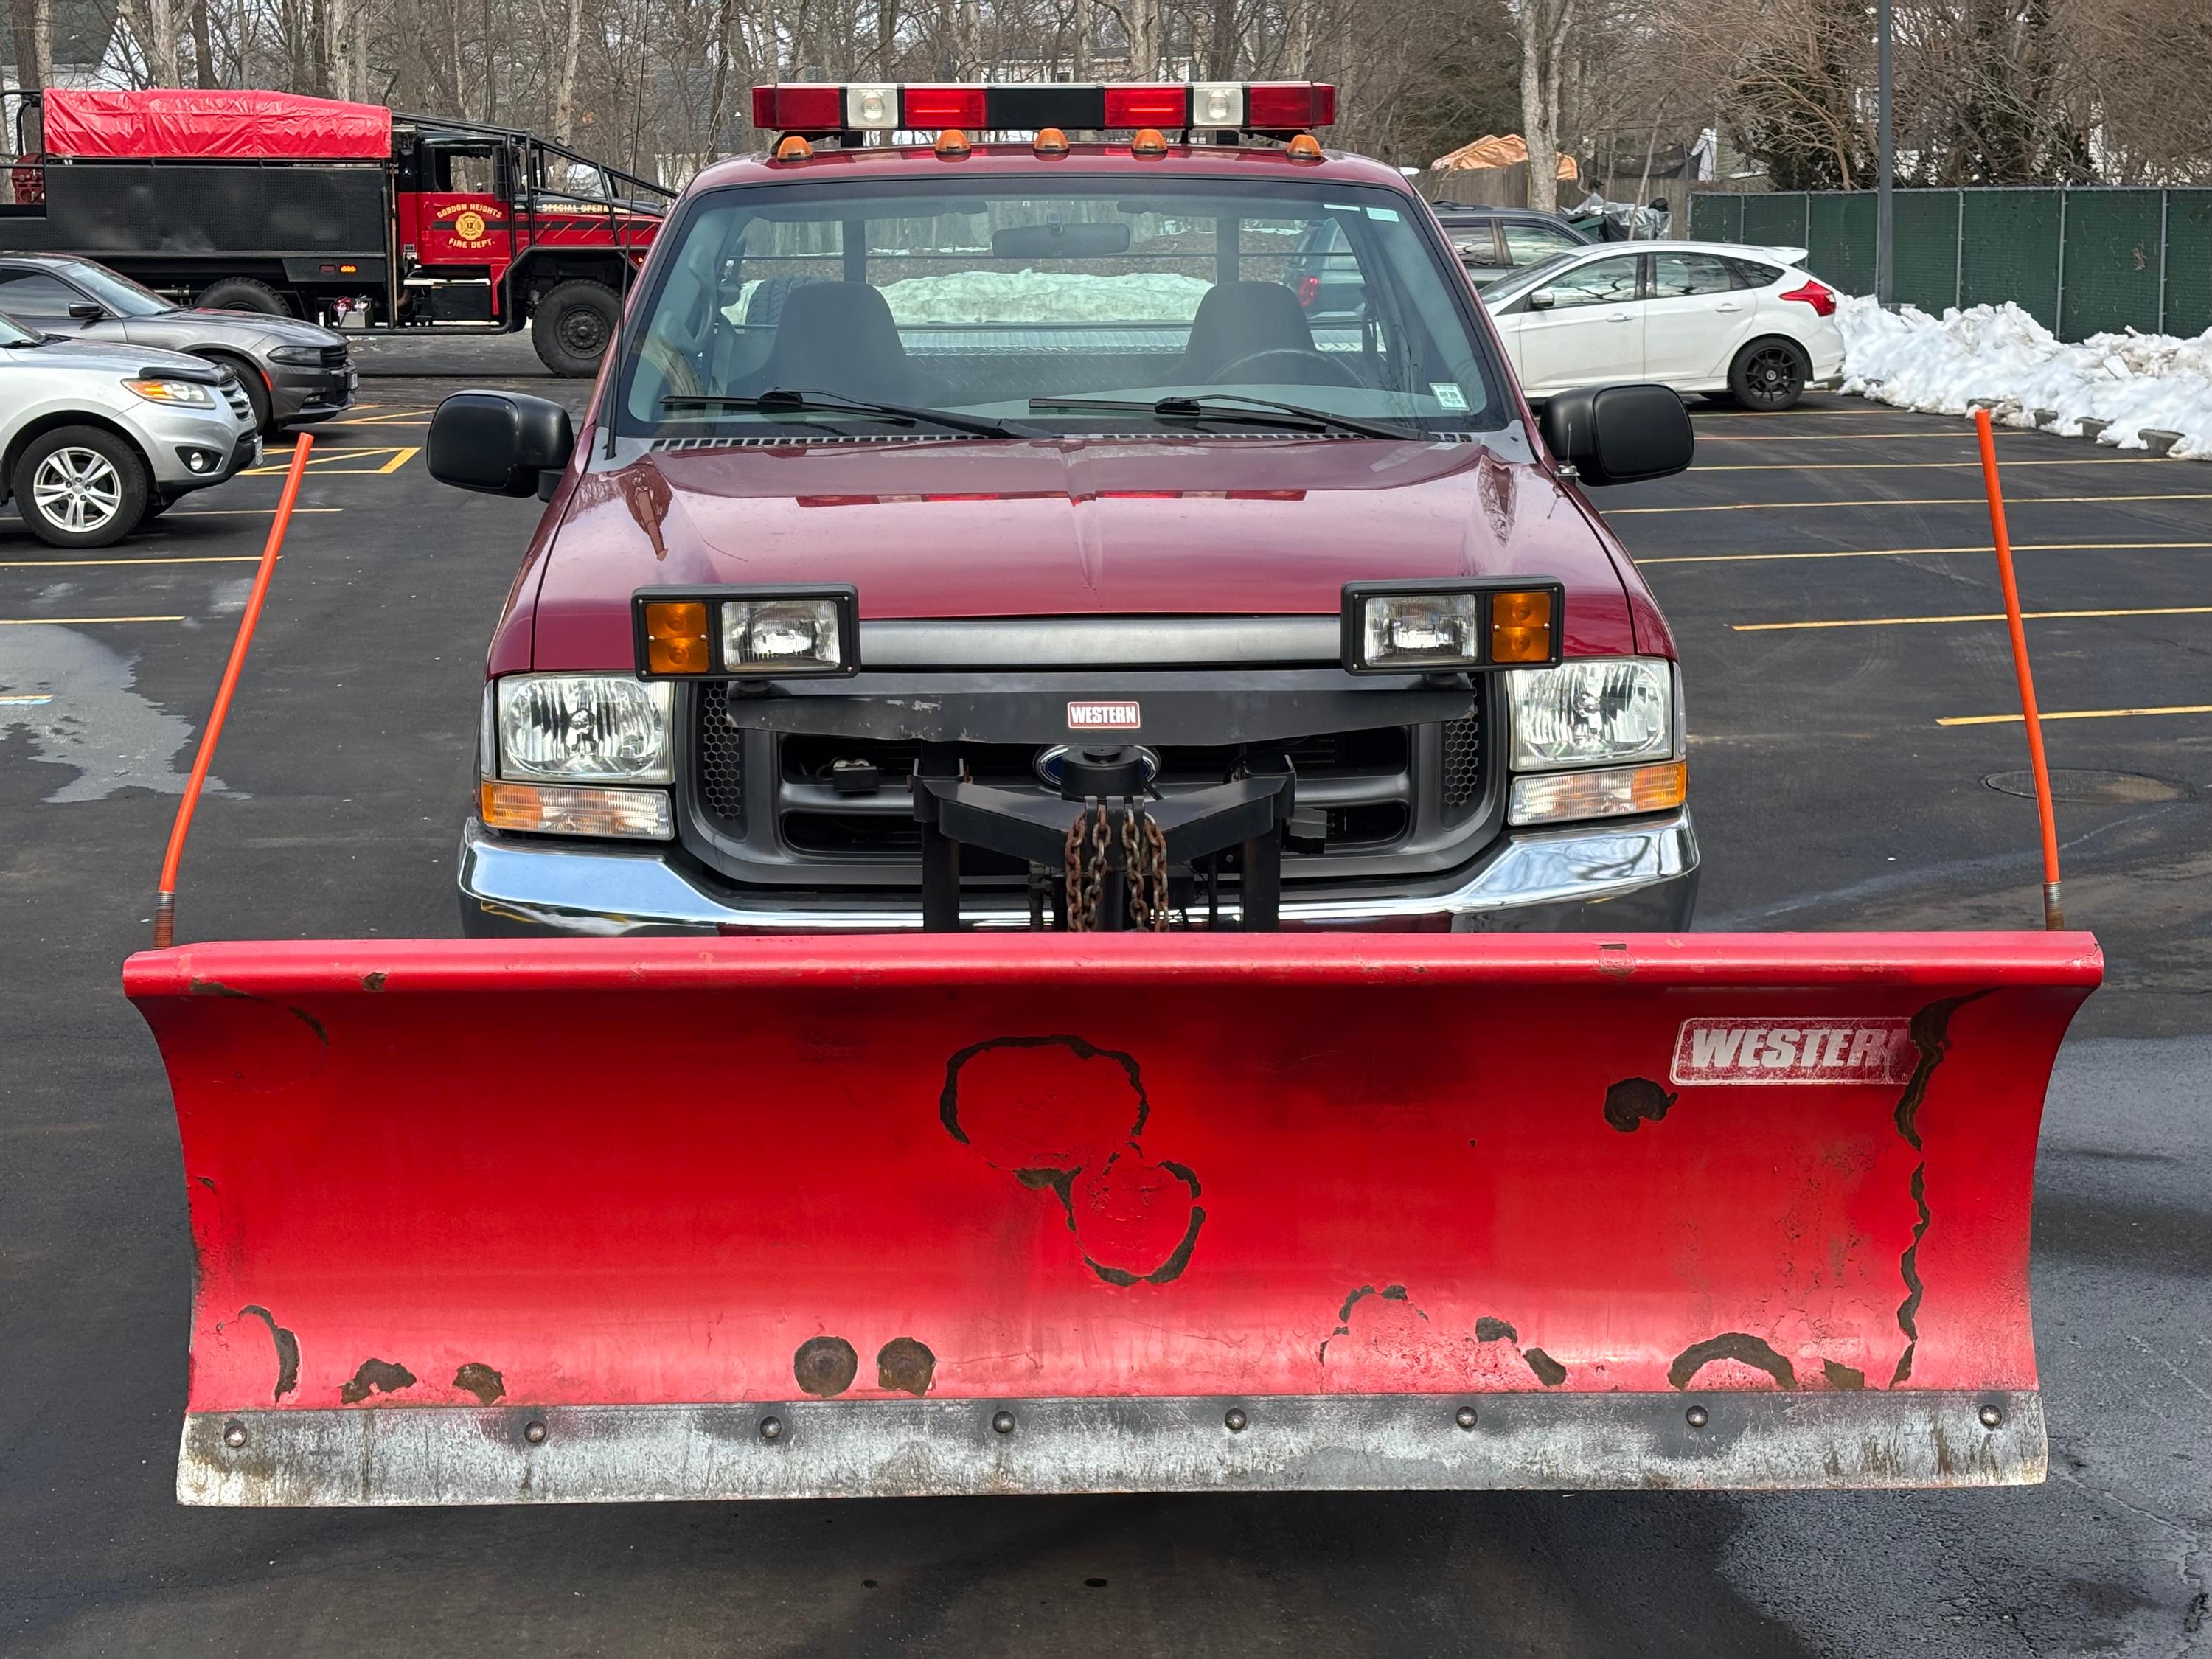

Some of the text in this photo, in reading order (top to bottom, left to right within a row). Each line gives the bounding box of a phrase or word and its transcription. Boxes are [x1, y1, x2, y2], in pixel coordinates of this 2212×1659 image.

[437, 203, 503, 219] GORDON HEIGHTS
[542, 204, 578, 212] SPECIAL
[448, 237, 495, 249] FIRE DEPT.
[1071, 706, 1136, 723] WESTERN
